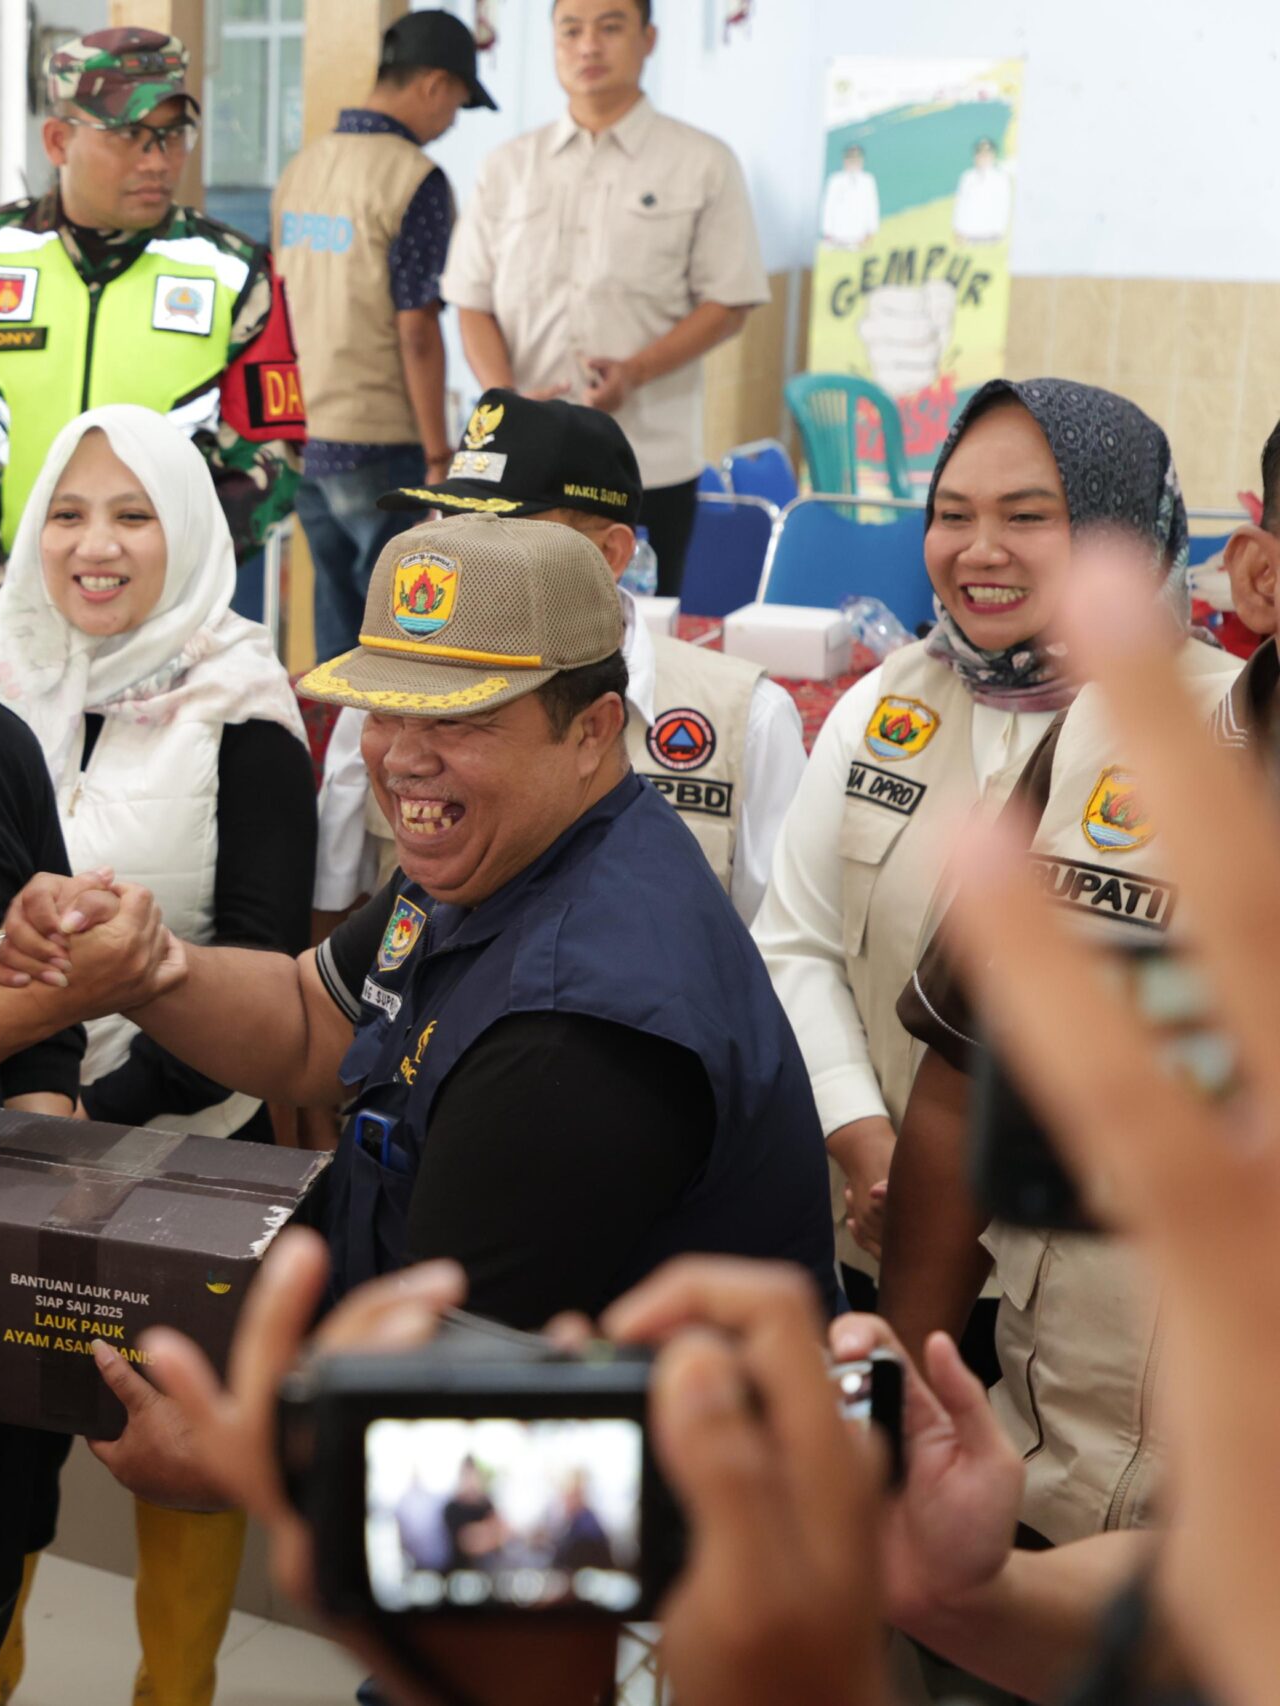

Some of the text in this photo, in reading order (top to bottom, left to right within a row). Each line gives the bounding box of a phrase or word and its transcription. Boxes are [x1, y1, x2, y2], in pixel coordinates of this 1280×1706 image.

[281, 212, 354, 254] BPBD
[831, 245, 991, 317] GEMPUR
[564, 483, 599, 501] WAKIL
[652, 781, 726, 808] PBD
[869, 776, 914, 806] DPRD
[10, 1273, 150, 1306] BANTUAN LAUK PAUK
[35, 1295, 123, 1319] SIAP SAJI 2025
[34, 1312, 125, 1339] LAUK PAUK
[3, 1329, 49, 1348] AYAM
[113, 1345, 158, 1366] ANIS
